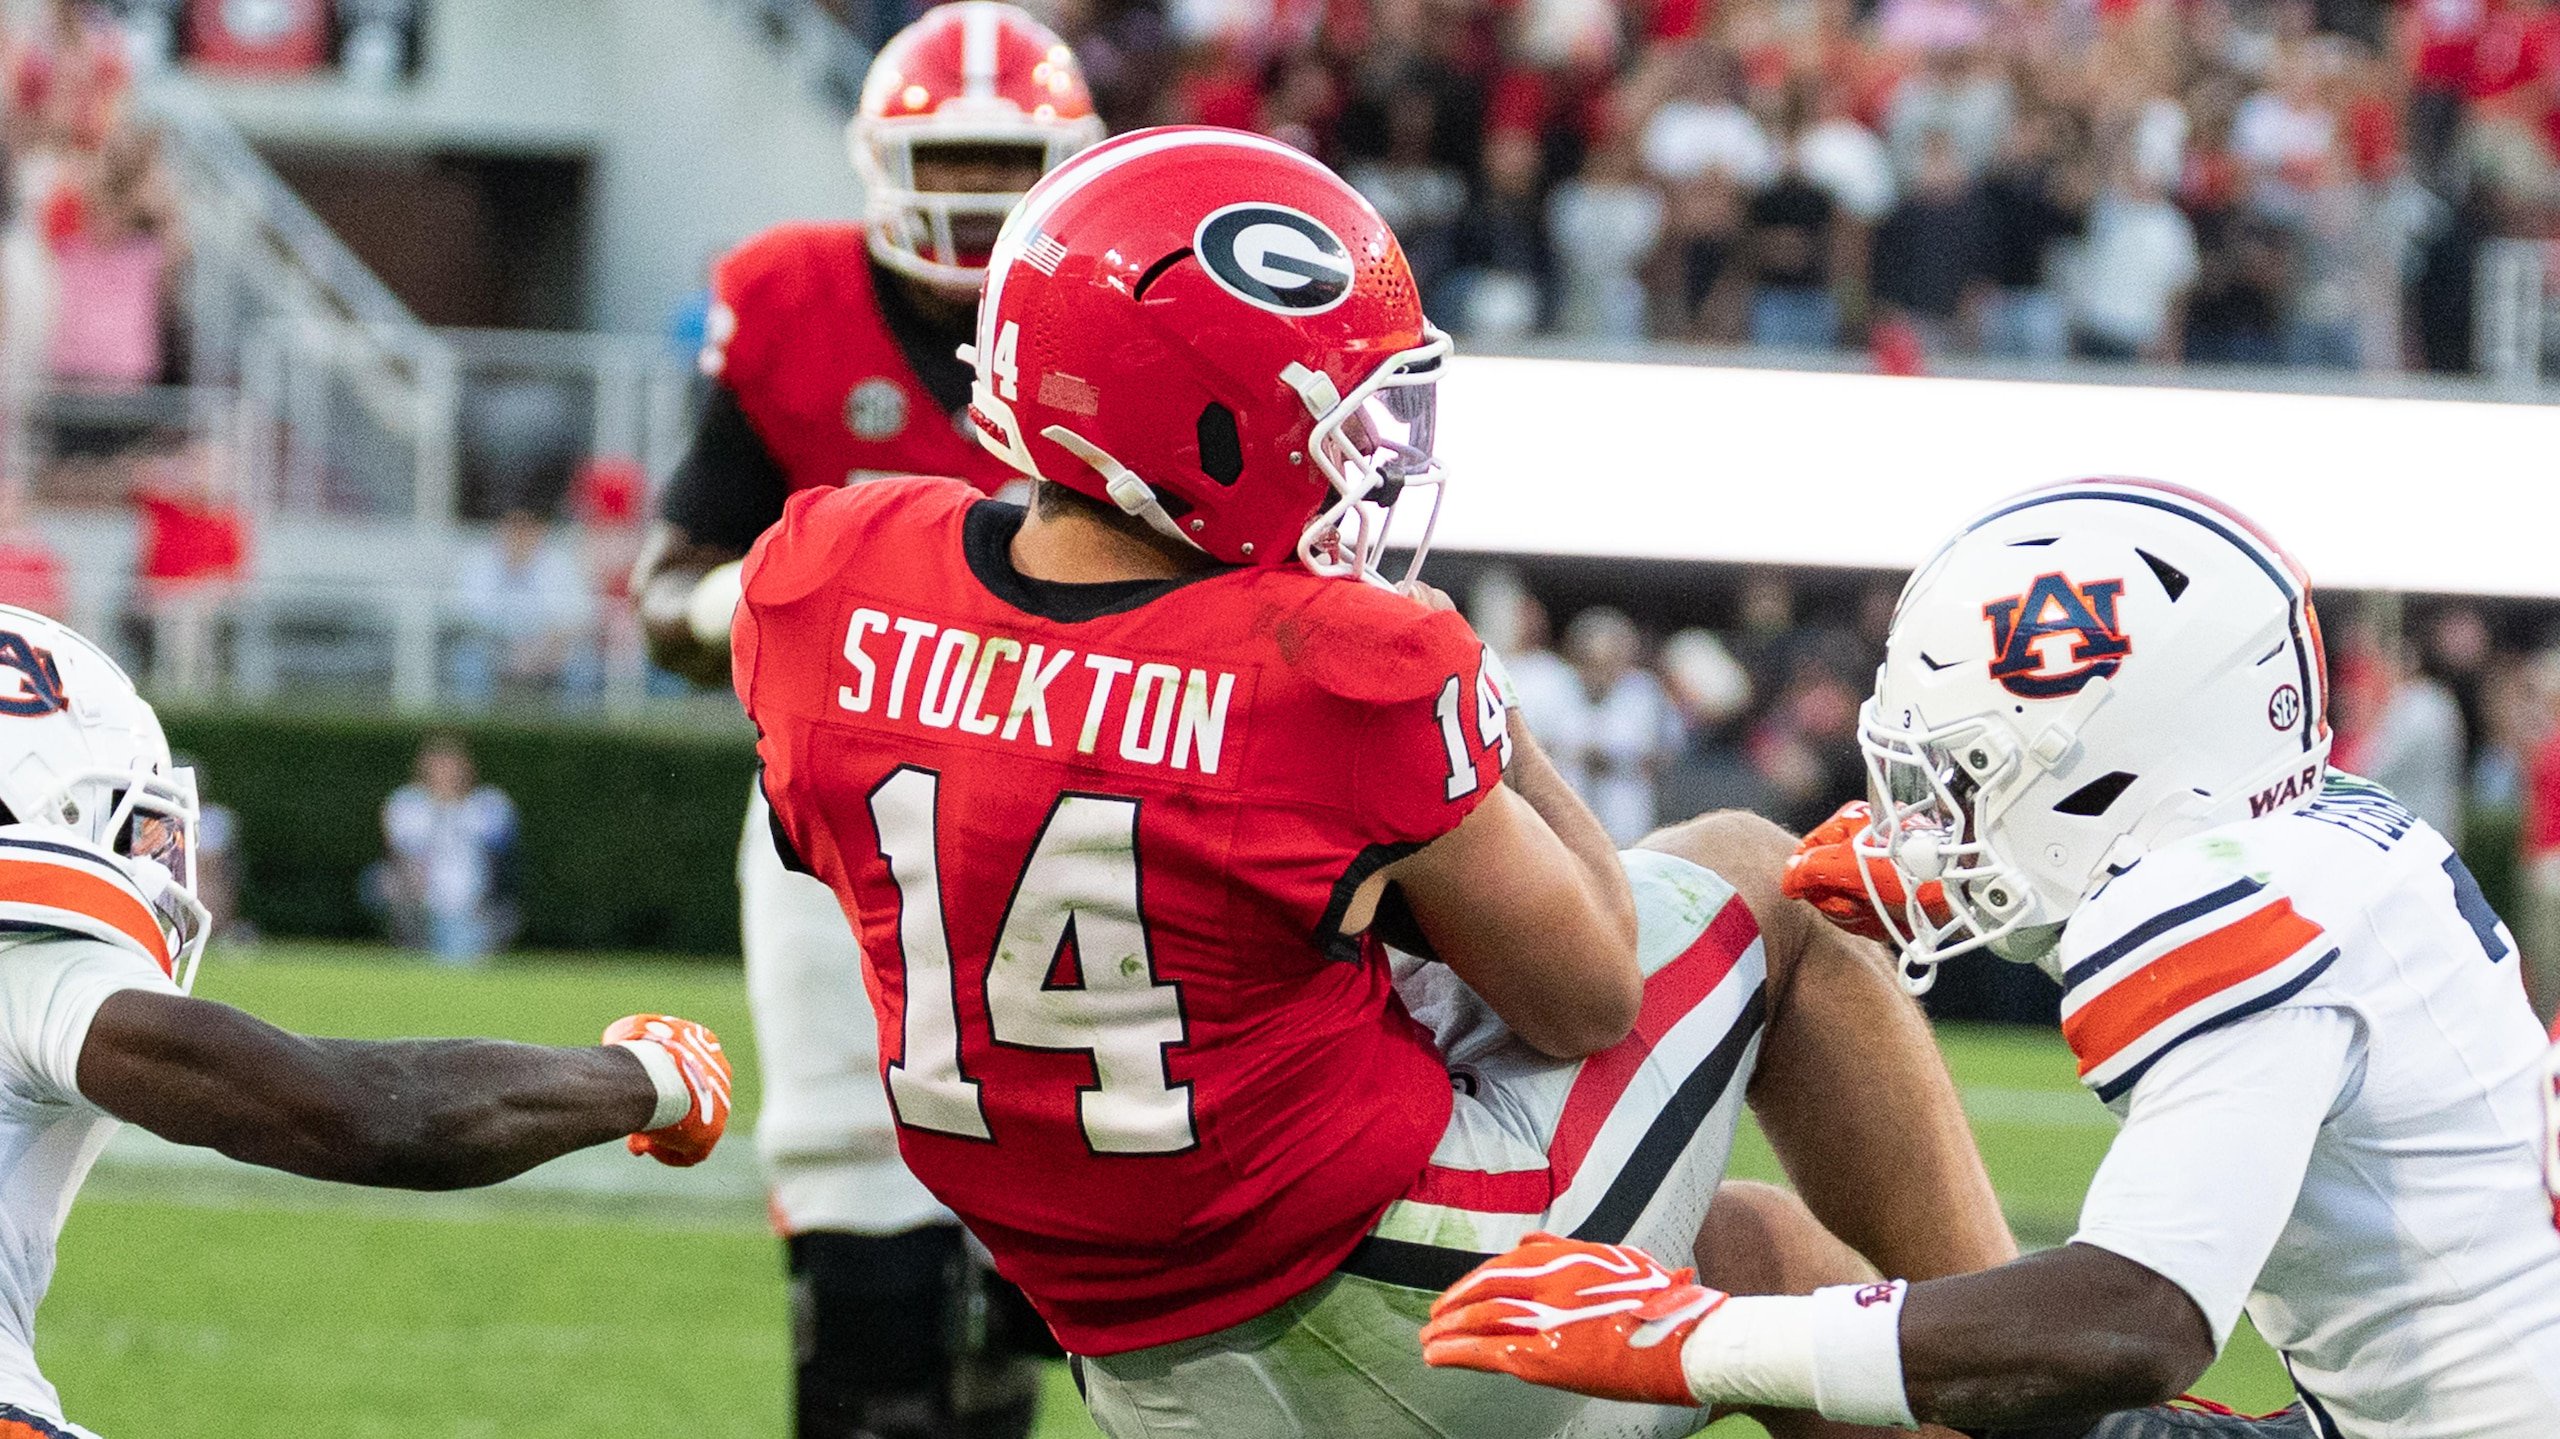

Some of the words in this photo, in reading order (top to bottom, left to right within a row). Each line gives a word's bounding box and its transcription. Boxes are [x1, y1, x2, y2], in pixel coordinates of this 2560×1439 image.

[1198, 206, 1352, 311] G
[837, 606, 1235, 773] STOCKTON
[1434, 643, 1513, 802] 14
[1903, 709, 1911, 729] 3
[2271, 686, 2298, 730] SEC
[2248, 764, 2316, 819] WAR
[868, 762, 1199, 1157] 14
